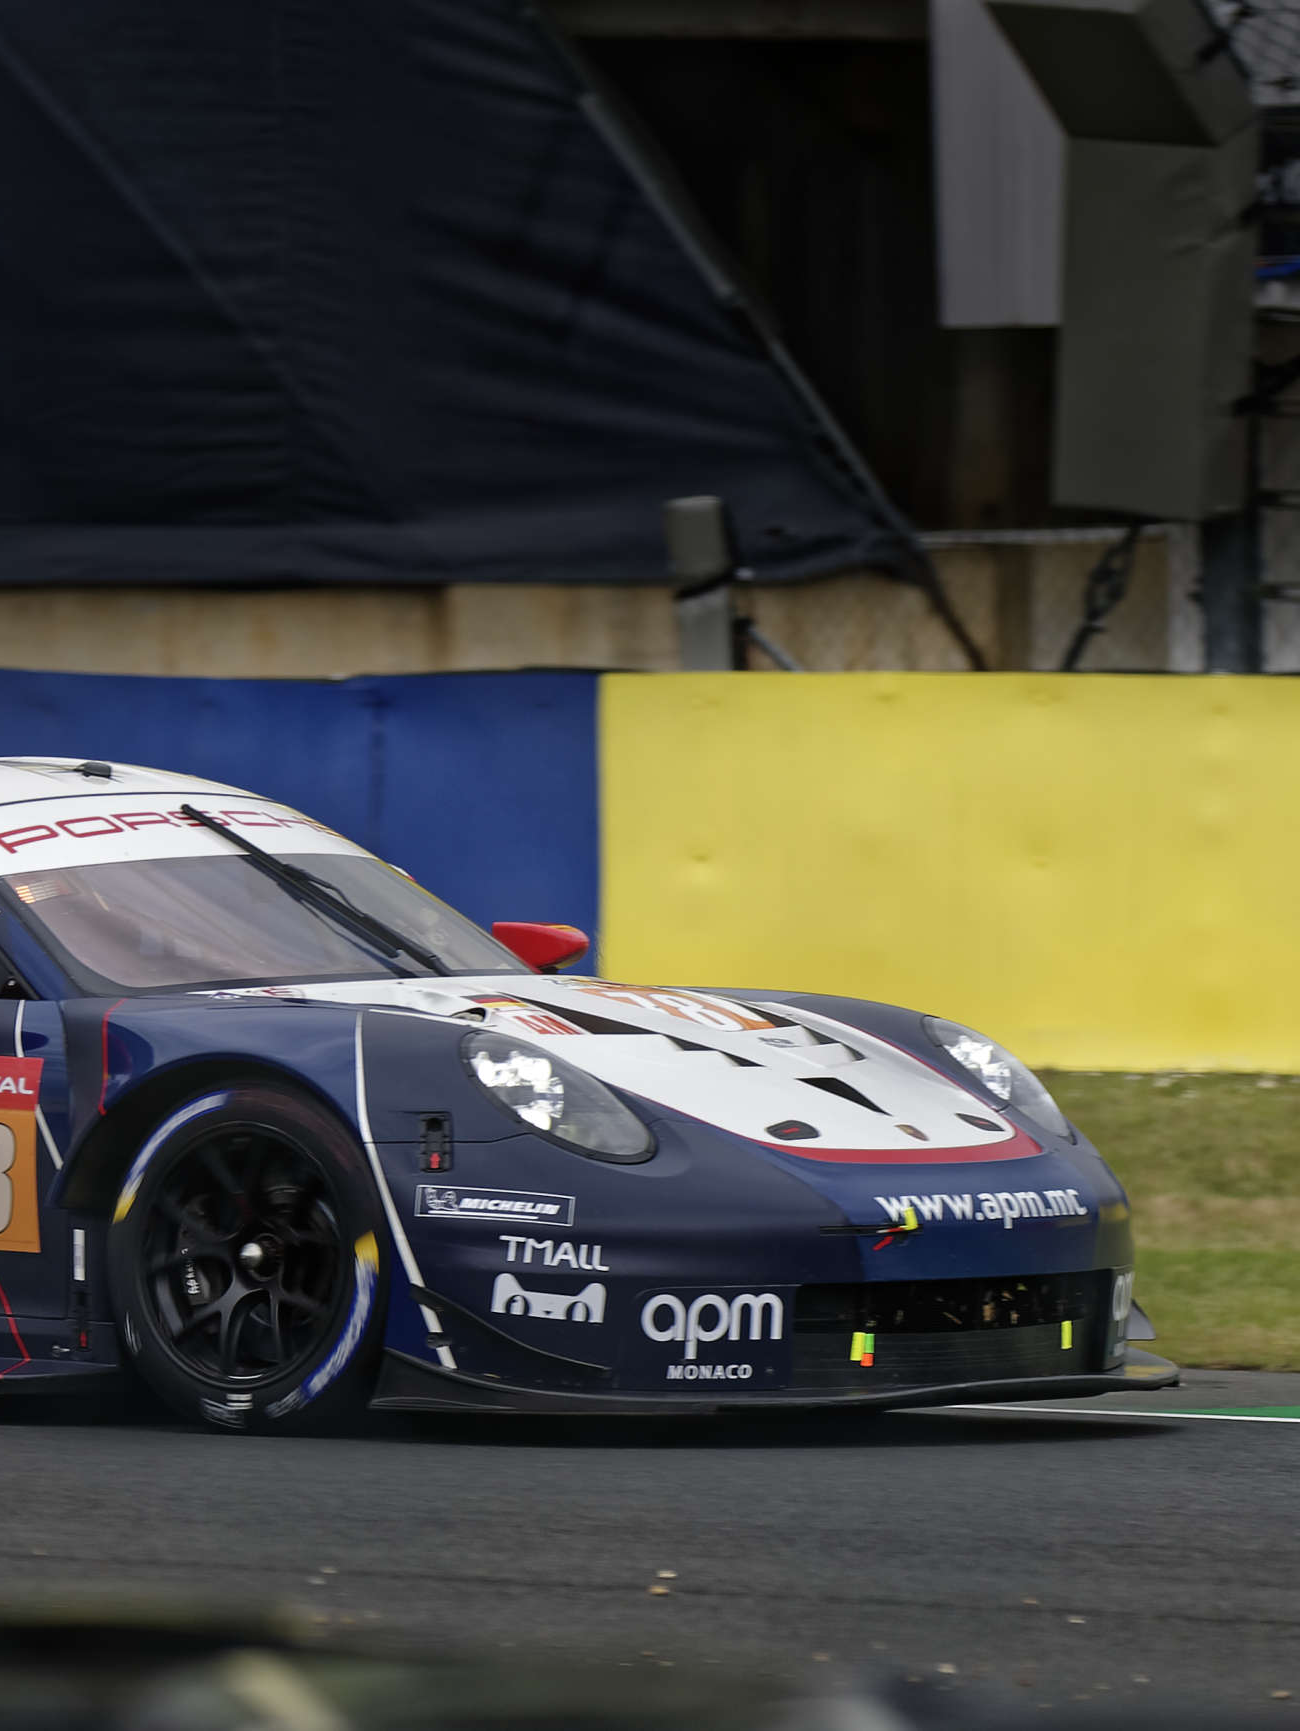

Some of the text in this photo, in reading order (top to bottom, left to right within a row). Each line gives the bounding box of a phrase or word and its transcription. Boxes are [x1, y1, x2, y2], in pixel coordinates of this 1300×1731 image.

[459, 1197, 560, 1215] MICHELIN
[874, 1188, 1089, 1229] www.apm.mc
[500, 1235, 610, 1272] TMALL
[641, 1293, 784, 1360] apm
[666, 1364, 753, 1380] MONACO
